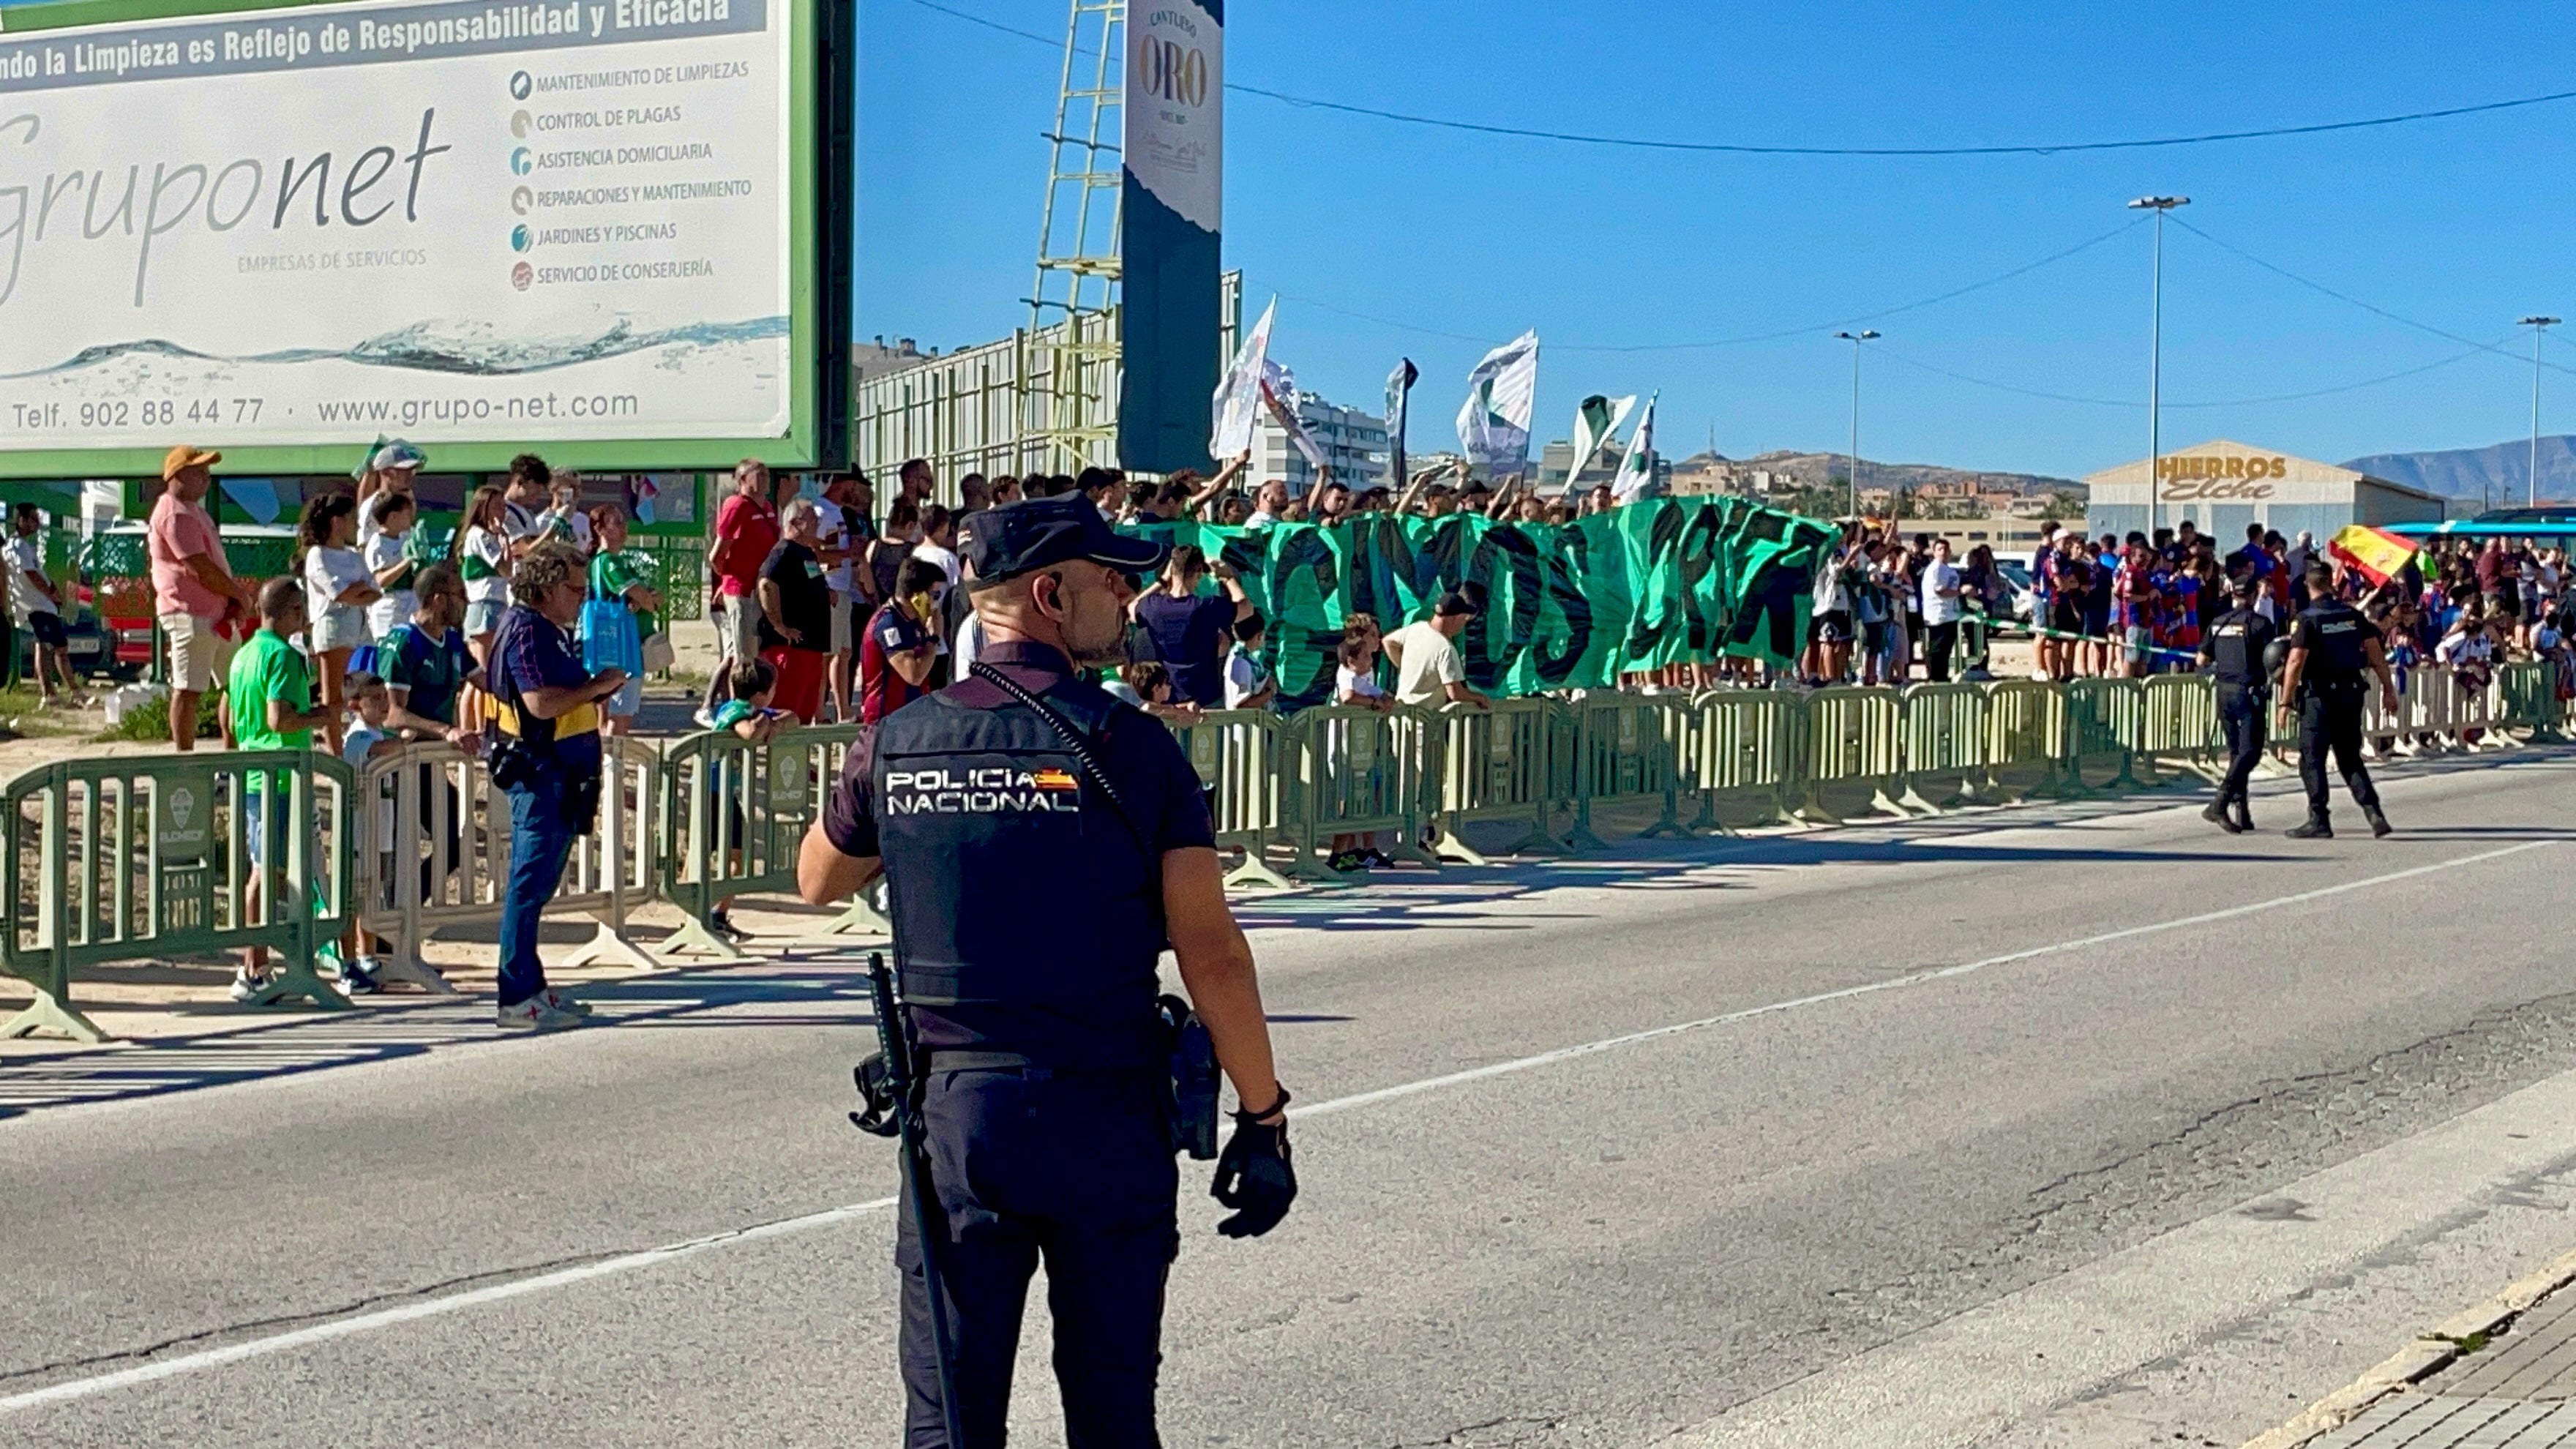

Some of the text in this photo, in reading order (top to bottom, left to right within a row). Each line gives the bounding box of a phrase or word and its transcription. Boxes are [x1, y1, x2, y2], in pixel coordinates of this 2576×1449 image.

[45, 47, 67, 76] la
[75, 40, 179, 76] Limpieza
[188, 40, 216, 64] es
[224, 26, 311, 63] Reflejo
[320, 23, 350, 53] de
[359, 2, 580, 53] Responsabilidad
[589, 6, 606, 37] y
[615, 0, 729, 29] Eficacia
[536, 61, 749, 93] MANTENIMIENTO DE LIMPIEZAS
[1139, 34, 1207, 108] ORO
[536, 105, 681, 132] CONTROL DE PLAGAS
[536, 143, 713, 170] ASISTENCIA DOMICILIARIA
[537, 179, 752, 208] REPARACIONES Y MANTENIMIENTO
[537, 222, 677, 246] JARDINES Y PISCINAS
[237, 248, 427, 274] EMPRESAS DE SERVICIOS
[537, 257, 714, 284] SERVICIO DE CONSERJERÍA
[12, 392, 638, 428] Telf. 902 88 44 77 www.grupo-net.com
[2157, 455, 2286, 480] HIERROS
[2160, 473, 2275, 501] Elche
[886, 792, 1079, 816] NACIONAL
